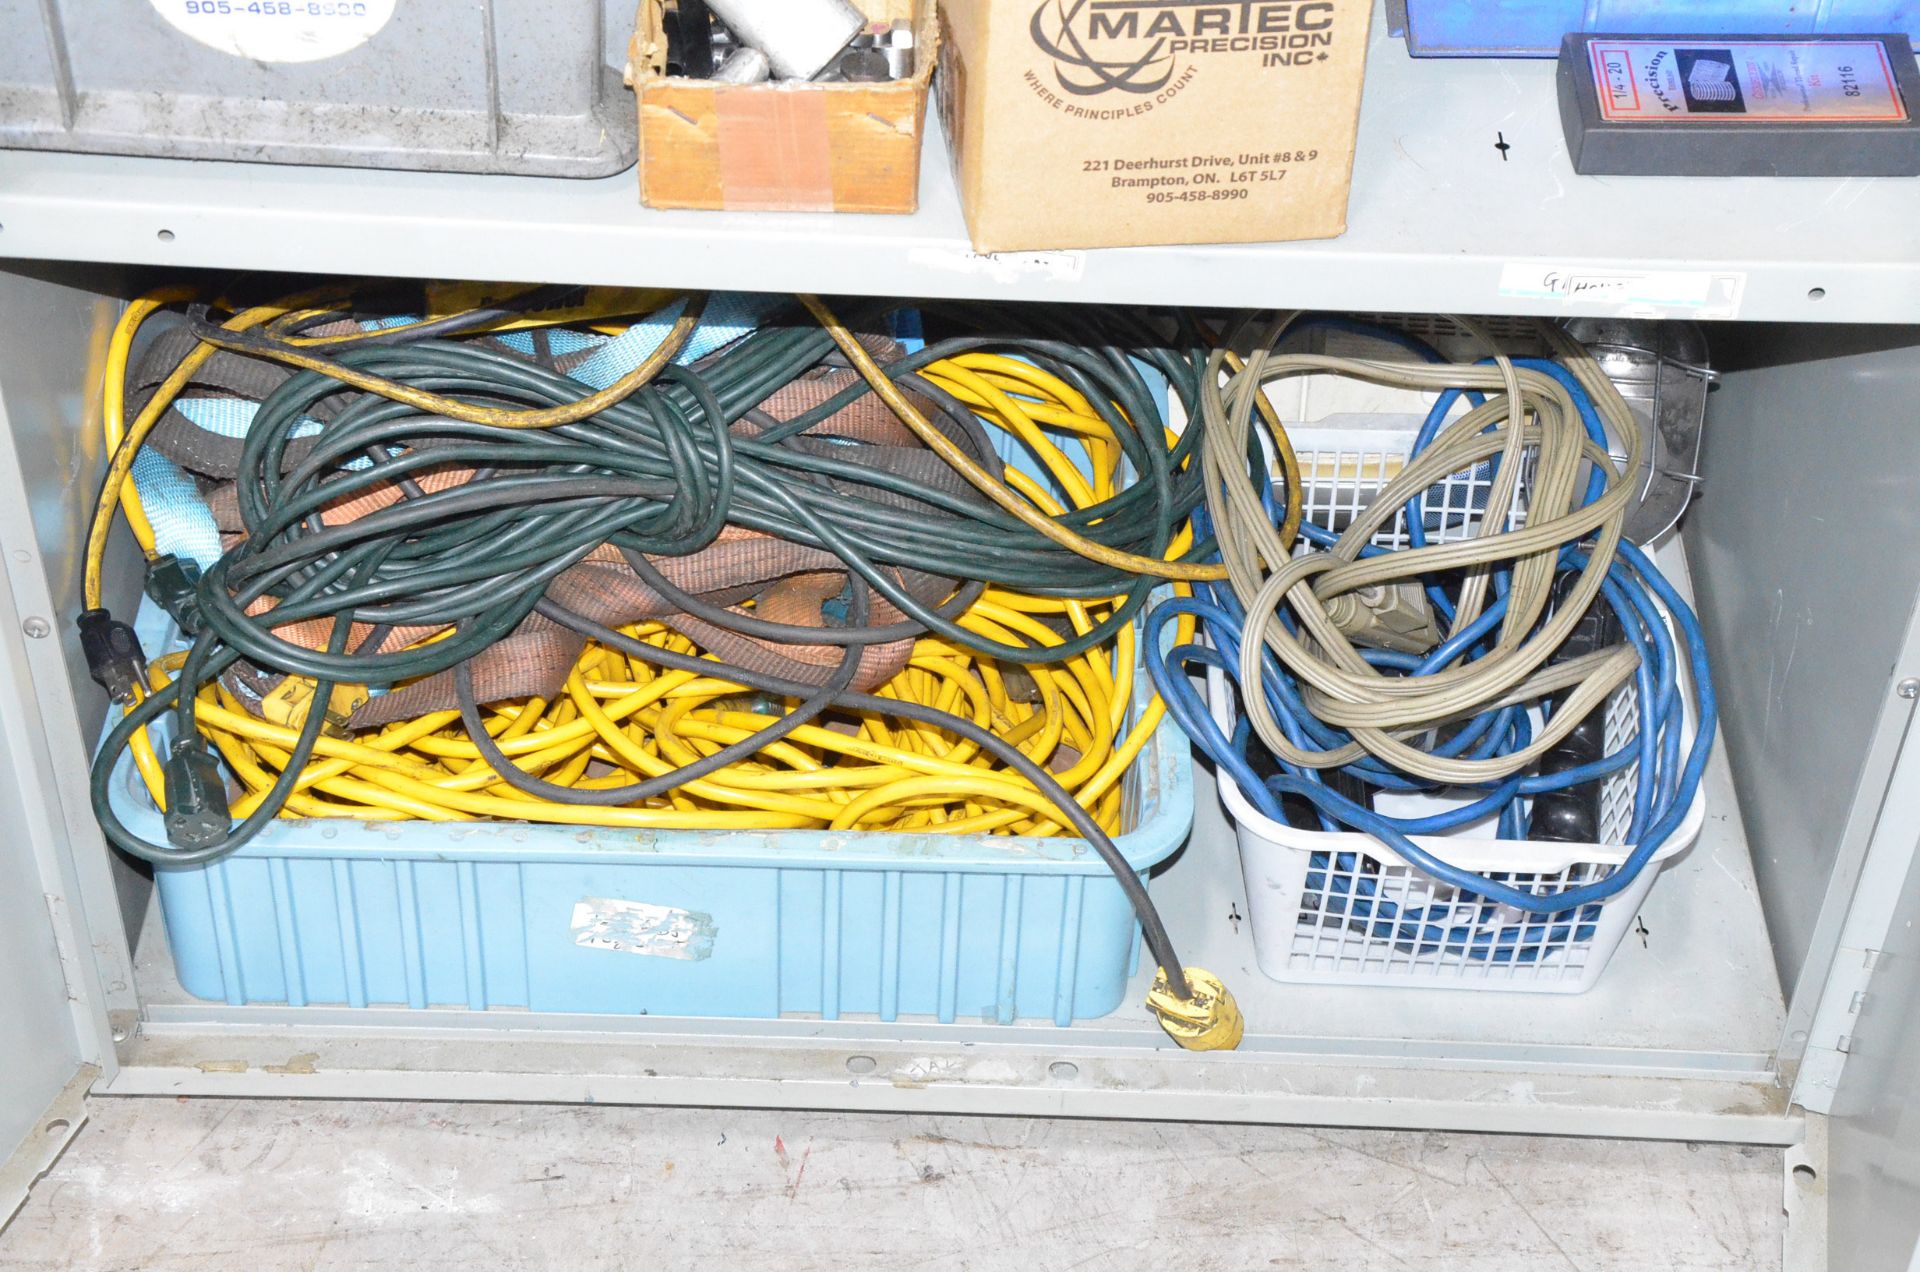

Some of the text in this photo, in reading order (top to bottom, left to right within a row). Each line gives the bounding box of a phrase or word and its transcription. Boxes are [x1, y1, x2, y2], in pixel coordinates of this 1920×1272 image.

[1089, 2, 1334, 39] MARTEC
[1169, 31, 1333, 54] PRECISION
[1262, 51, 1313, 67] INC
[1606, 61, 1624, 75] 20
[1024, 64, 1198, 121] WHERE PRINCIPLES COUNT
[1609, 83, 1628, 100] 1/4
[1643, 50, 1681, 113] Precision
[1837, 65, 1861, 97] 82116
[1082, 149, 1319, 172] 221 Deerhurst Drive, Unit #8 & 9
[1111, 169, 1288, 189] Brampton, ON. L6T 5L7
[1146, 188, 1249, 204] 905-458-8990
